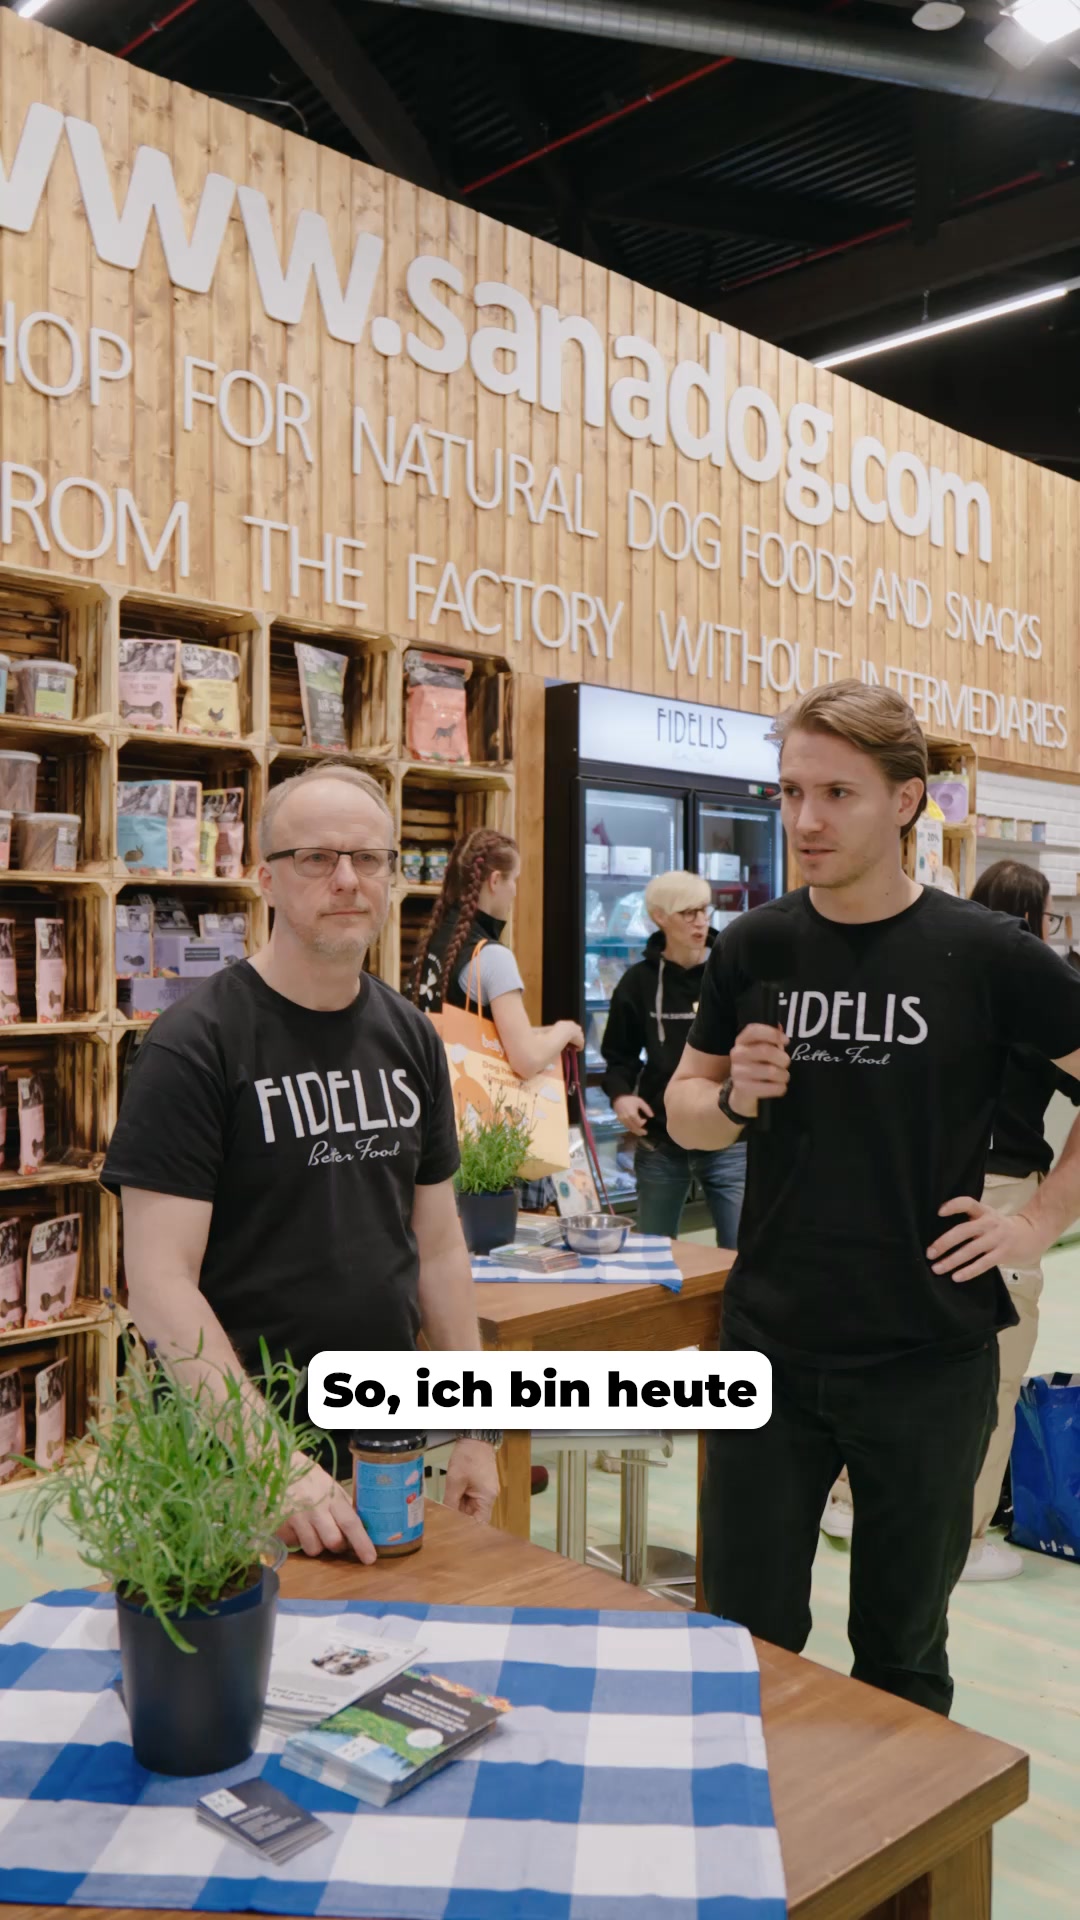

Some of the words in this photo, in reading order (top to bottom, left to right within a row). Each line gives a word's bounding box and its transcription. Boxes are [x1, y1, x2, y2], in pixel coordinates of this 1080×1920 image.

[184, 355, 313, 463] FOR
[353, 406, 598, 539] NATURAL
[628, 489, 721, 571] DOG
[741, 525, 856, 608] FOODS
[869, 568, 932, 629] AND
[946, 591, 1042, 660] SNACKS
[243, 516, 367, 611] THE
[408, 553, 624, 660] FACTORY
[658, 610, 842, 695] WITHOUT
[657, 707, 728, 750] FIDELIS
[791, 1043, 842, 1062] Better
[845, 1045, 891, 1066] Food
[253, 1068, 421, 1143] FIDELIS
[355, 1134, 400, 1160] Food
